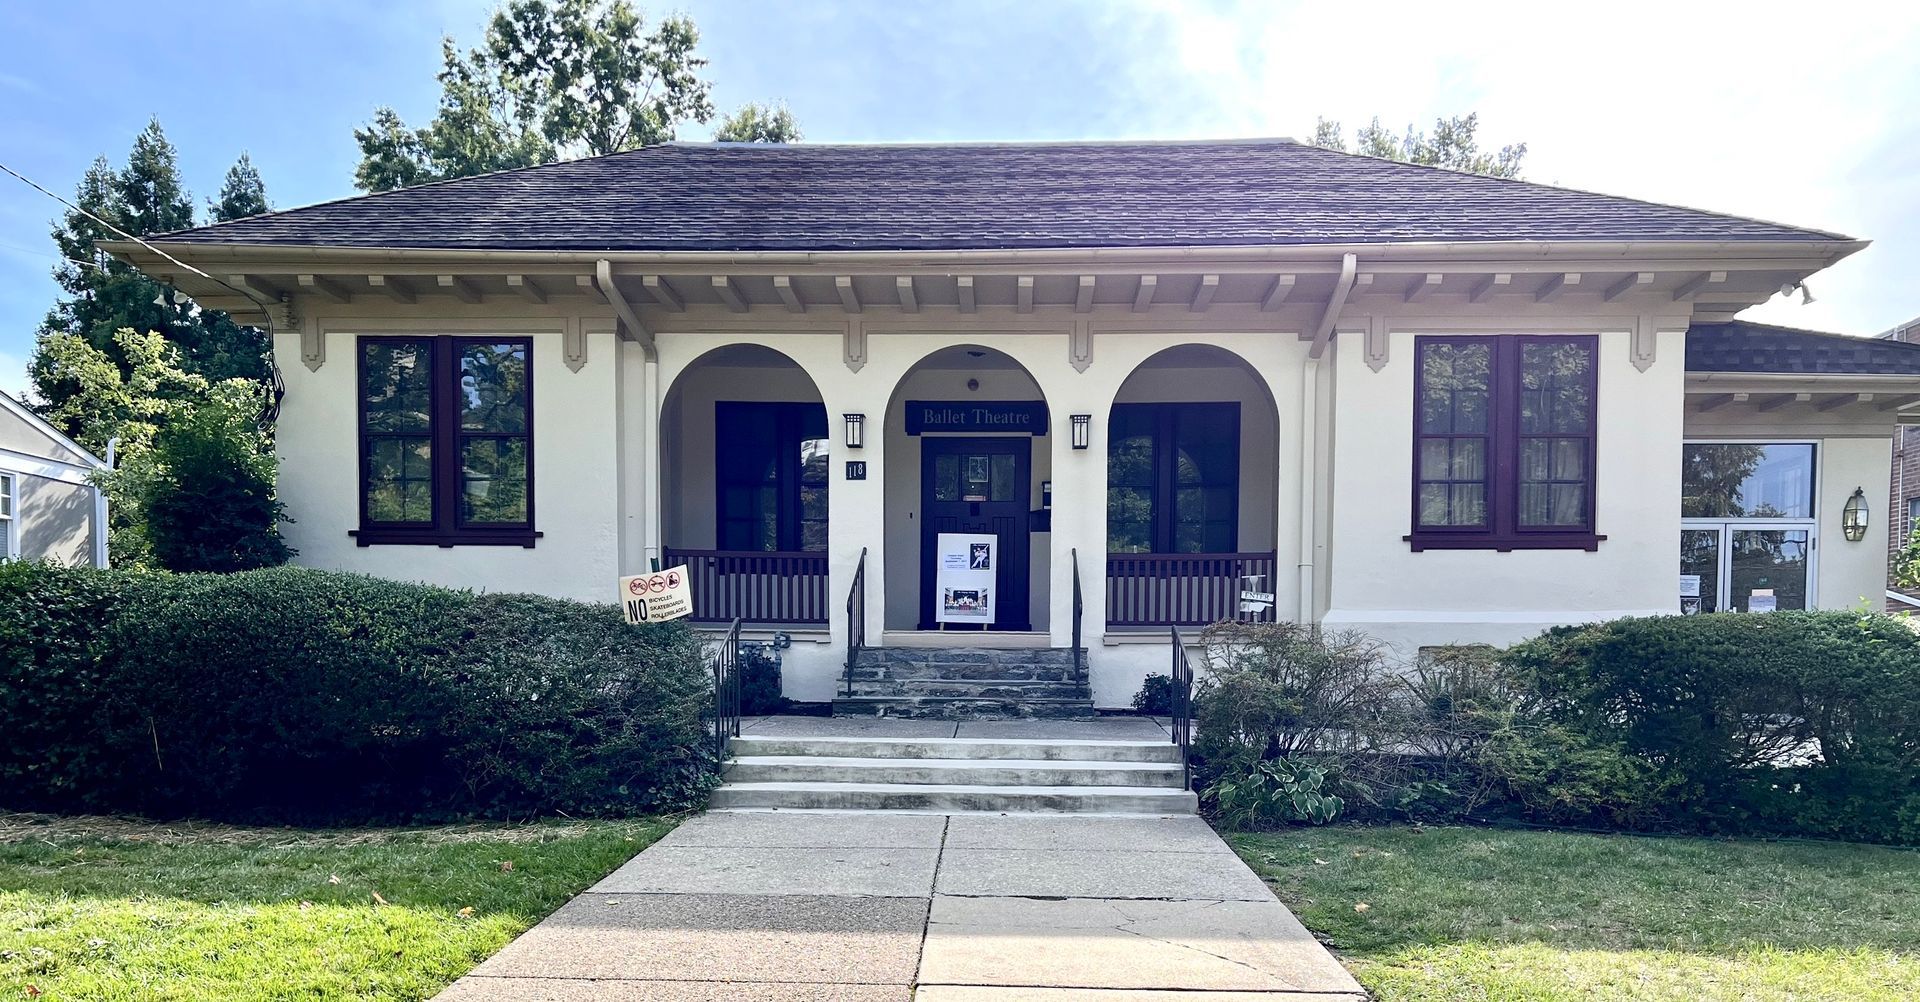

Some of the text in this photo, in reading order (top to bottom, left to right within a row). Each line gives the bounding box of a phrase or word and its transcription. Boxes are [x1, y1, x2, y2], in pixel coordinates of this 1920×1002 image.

[924, 408, 1030, 424] Ballet Theatre
[849, 463, 863, 479] 118
[649, 594, 673, 604] BICYCLES
[1244, 591, 1271, 600] ENTER
[627, 598, 648, 622] NO
[650, 599, 685, 611] SKATEBOARDS
[651, 606, 688, 619] ROLLERBLADES
